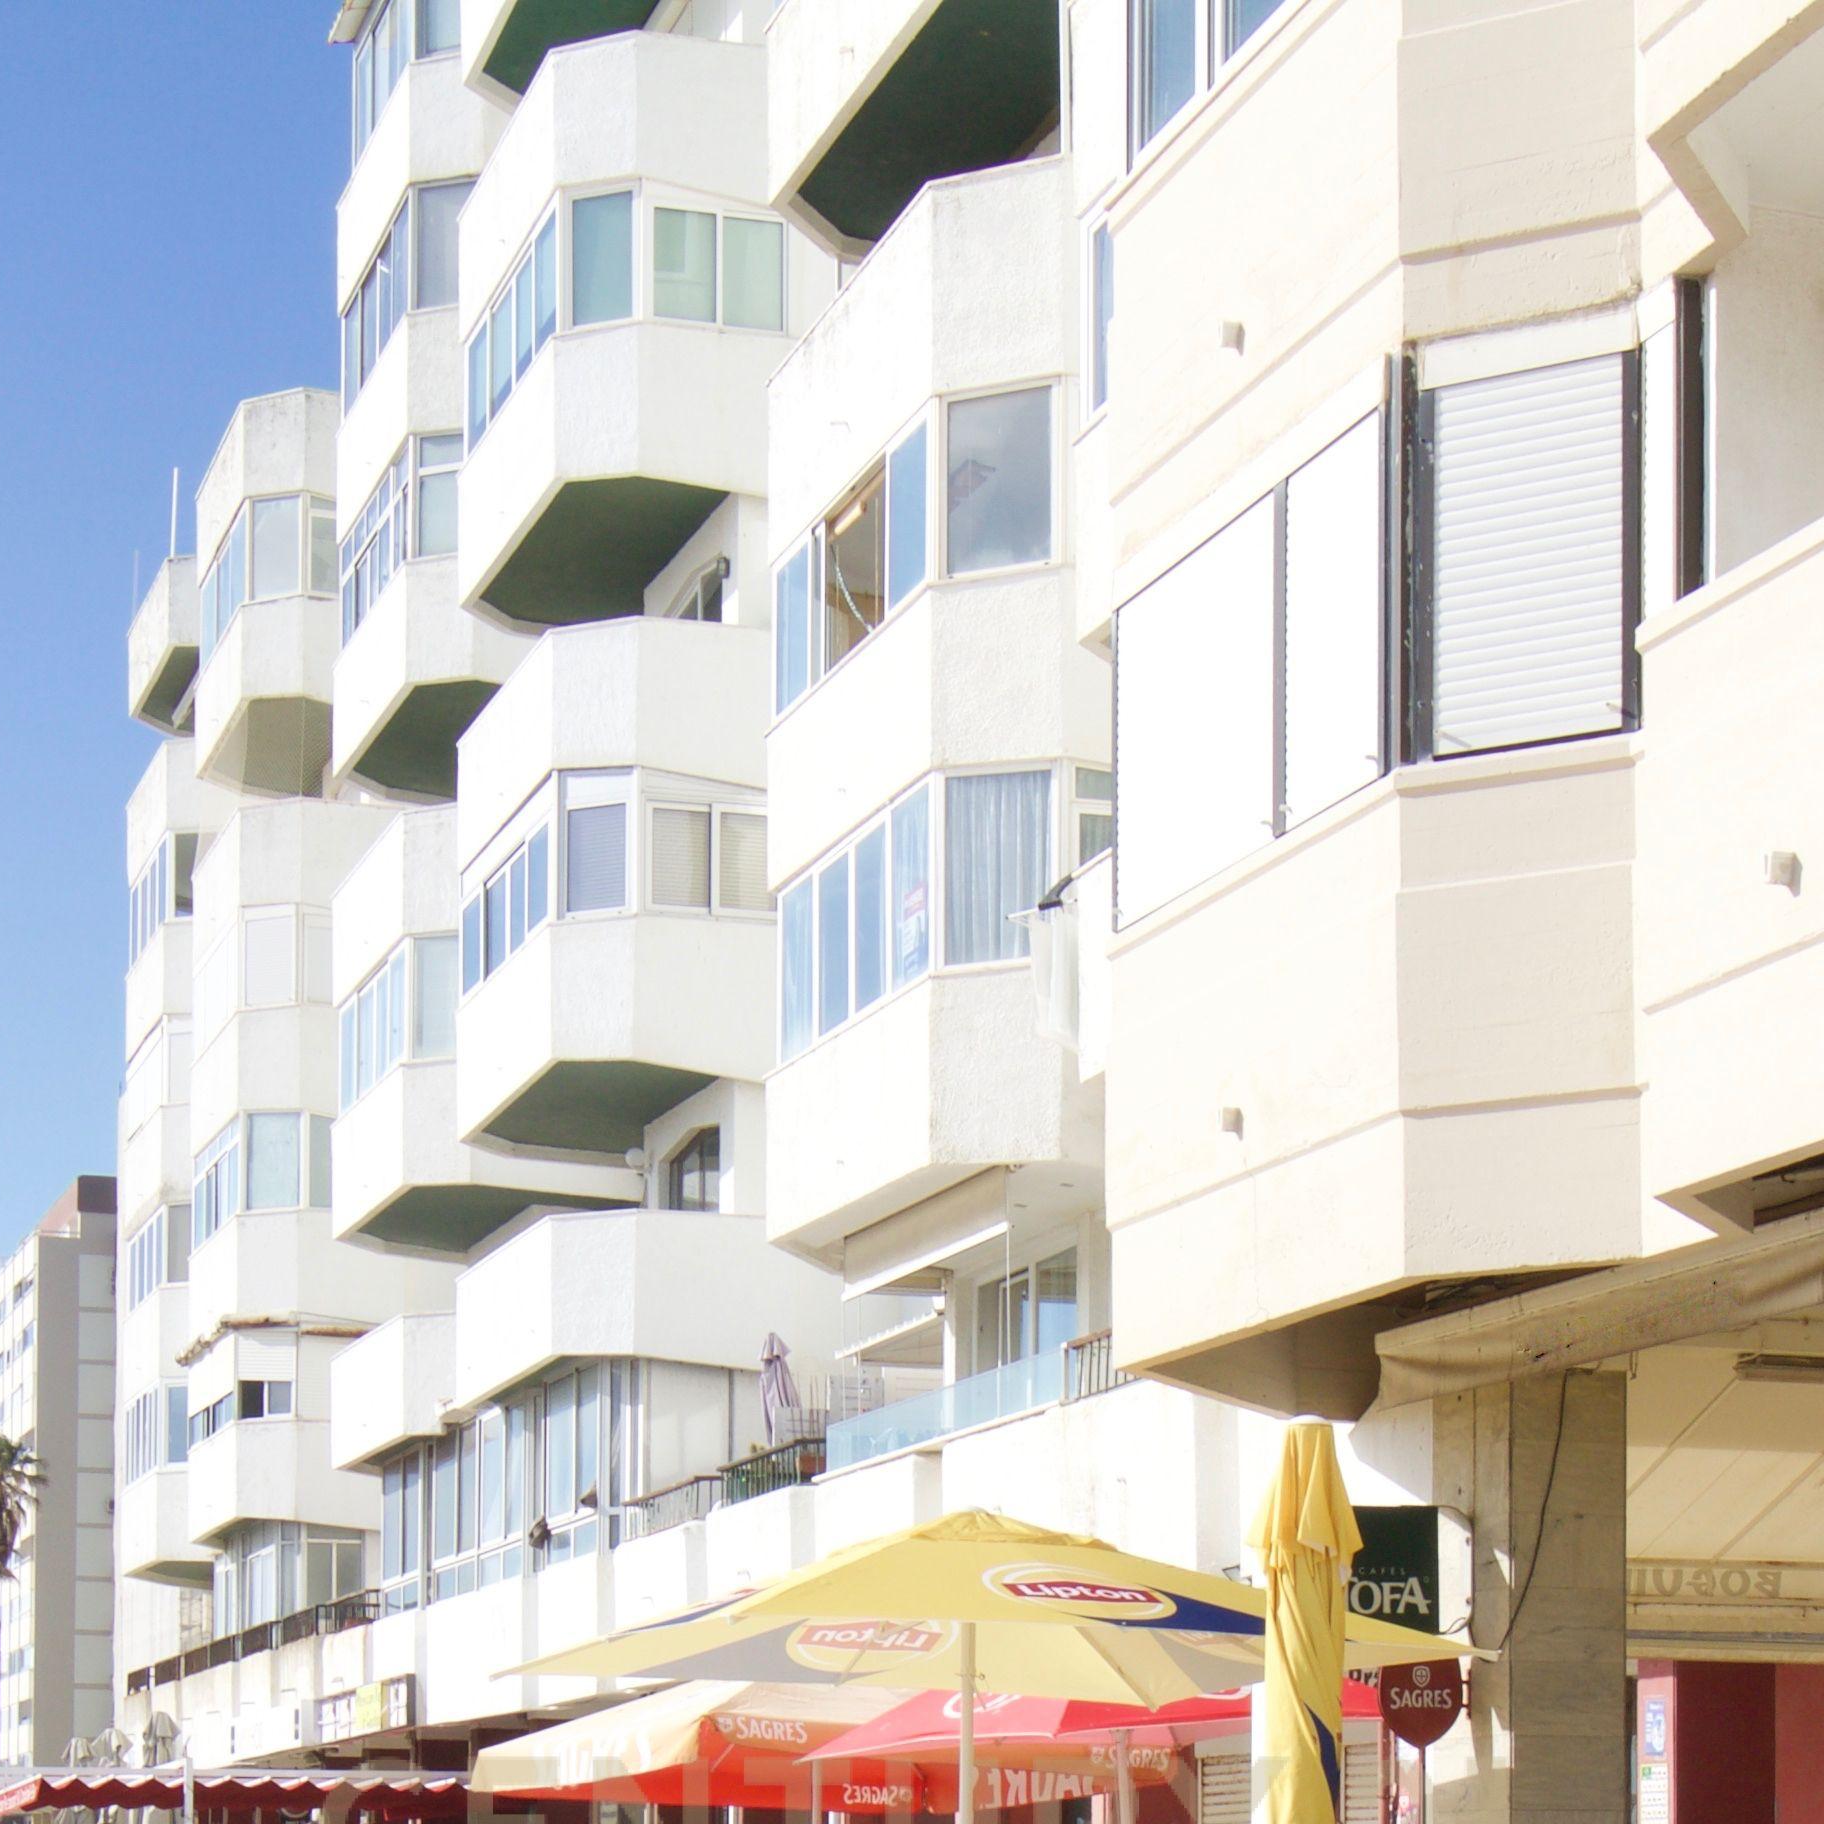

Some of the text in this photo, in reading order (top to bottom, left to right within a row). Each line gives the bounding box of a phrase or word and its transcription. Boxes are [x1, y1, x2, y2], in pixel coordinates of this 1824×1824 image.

[1018, 1582, 1147, 1602] Lipton
[1346, 1576, 1432, 1615] OFA
[1390, 1687, 1452, 1710] SAGRES
[735, 1716, 808, 1744] SAGRES
[1105, 1746, 1172, 1772] SGRES
